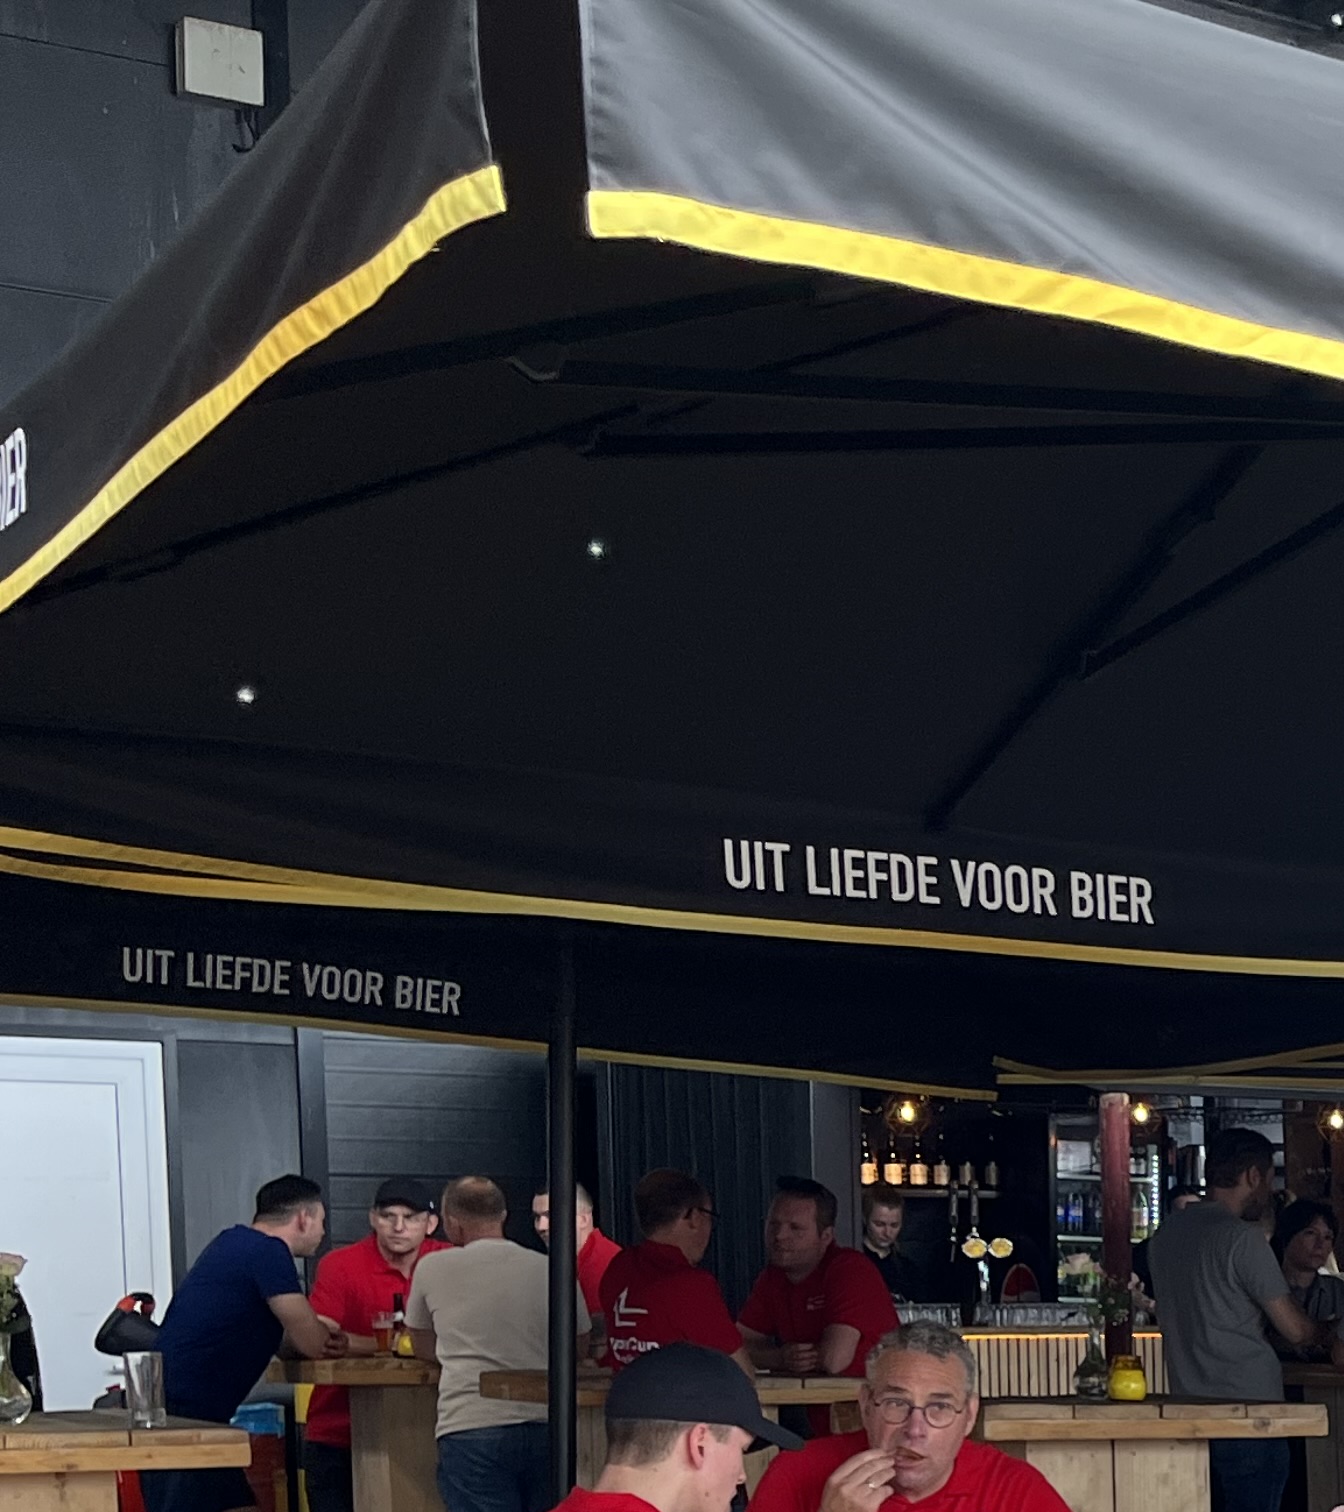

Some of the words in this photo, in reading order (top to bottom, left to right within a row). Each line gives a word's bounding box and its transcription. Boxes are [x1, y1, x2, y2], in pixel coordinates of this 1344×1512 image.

[0, 427, 27, 531] IER
[723, 838, 790, 891] UIT
[805, 845, 940, 904] LIEFDE
[950, 859, 1057, 916] VOOR
[1070, 871, 1155, 924] BIER
[122, 946, 175, 985] UIT
[186, 952, 292, 995] LIEFDE
[302, 962, 384, 1006] VOOR
[395, 975, 462, 1016] BIER
